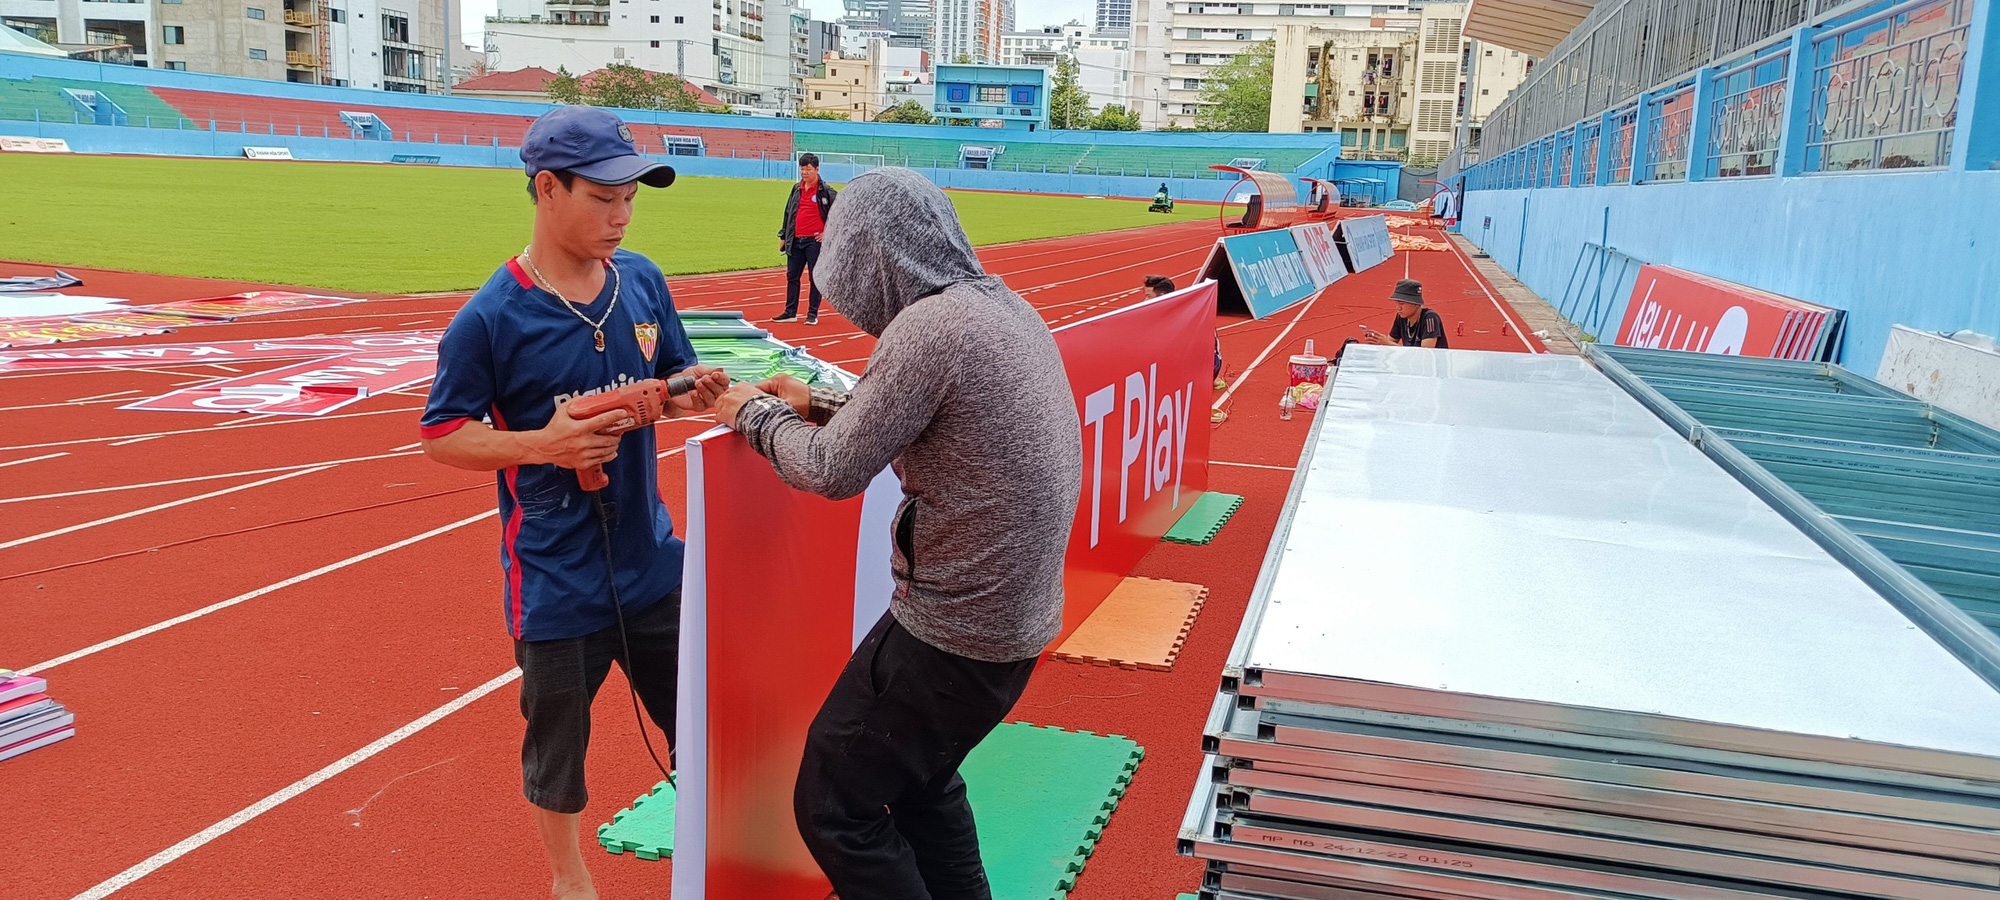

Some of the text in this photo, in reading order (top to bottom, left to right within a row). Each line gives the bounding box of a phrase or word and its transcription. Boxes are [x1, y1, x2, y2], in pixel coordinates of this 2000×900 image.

[1119, 362, 1193, 524] Play
[1262, 834, 1283, 842] MP
[1323, 842, 1408, 859] 24/12/22
[1418, 855, 1473, 868] 01:25
